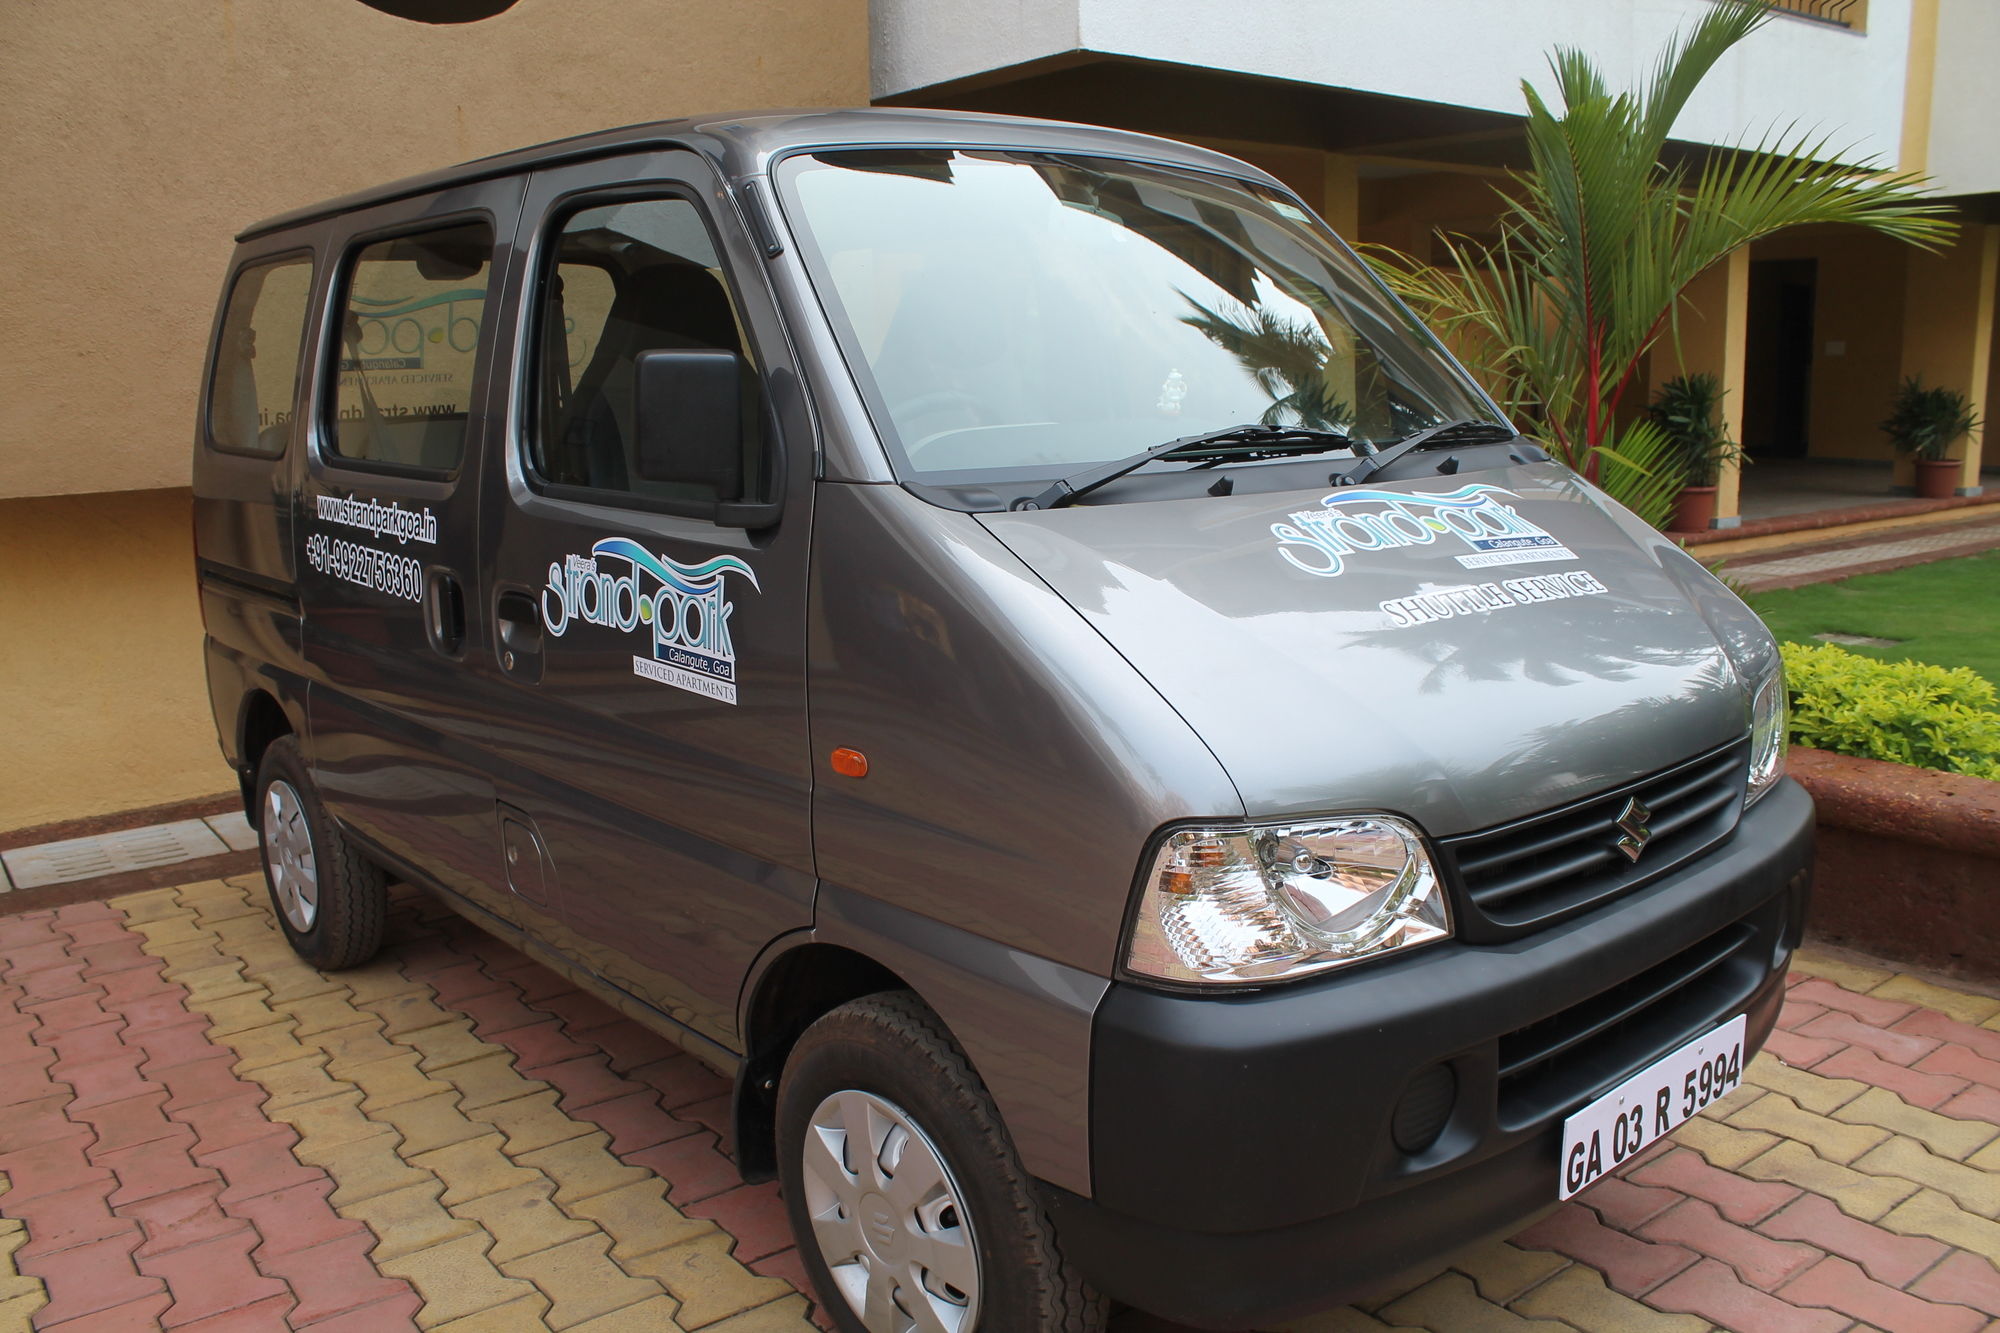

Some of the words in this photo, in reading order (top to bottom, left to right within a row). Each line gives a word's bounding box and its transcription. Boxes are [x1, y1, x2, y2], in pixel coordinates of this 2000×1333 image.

[316, 493, 436, 544] www.strandparkgoa.in
[572, 554, 595, 571] Veera's
[1461, 553, 1512, 567] SERVICED
[1512, 549, 1574, 562] APARTMENTS
[1488, 538, 1536, 549] Calangute,
[1534, 536, 1554, 546] Goa
[306, 534, 422, 602] +91-9922756360
[1381, 584, 1514, 626] SHUTTLE
[1503, 571, 1607, 603] SERVICE
[635, 661, 675, 683] SERVICED
[676, 670, 735, 701] APARTMENTS
[669, 648, 710, 672] Calangute,
[713, 660, 730, 676] Goa
[1566, 1129, 1602, 1194] GA
[1613, 1104, 1643, 1163] 03
[1655, 1086, 1671, 1137] R
[1682, 1042, 1740, 1119] 5994
